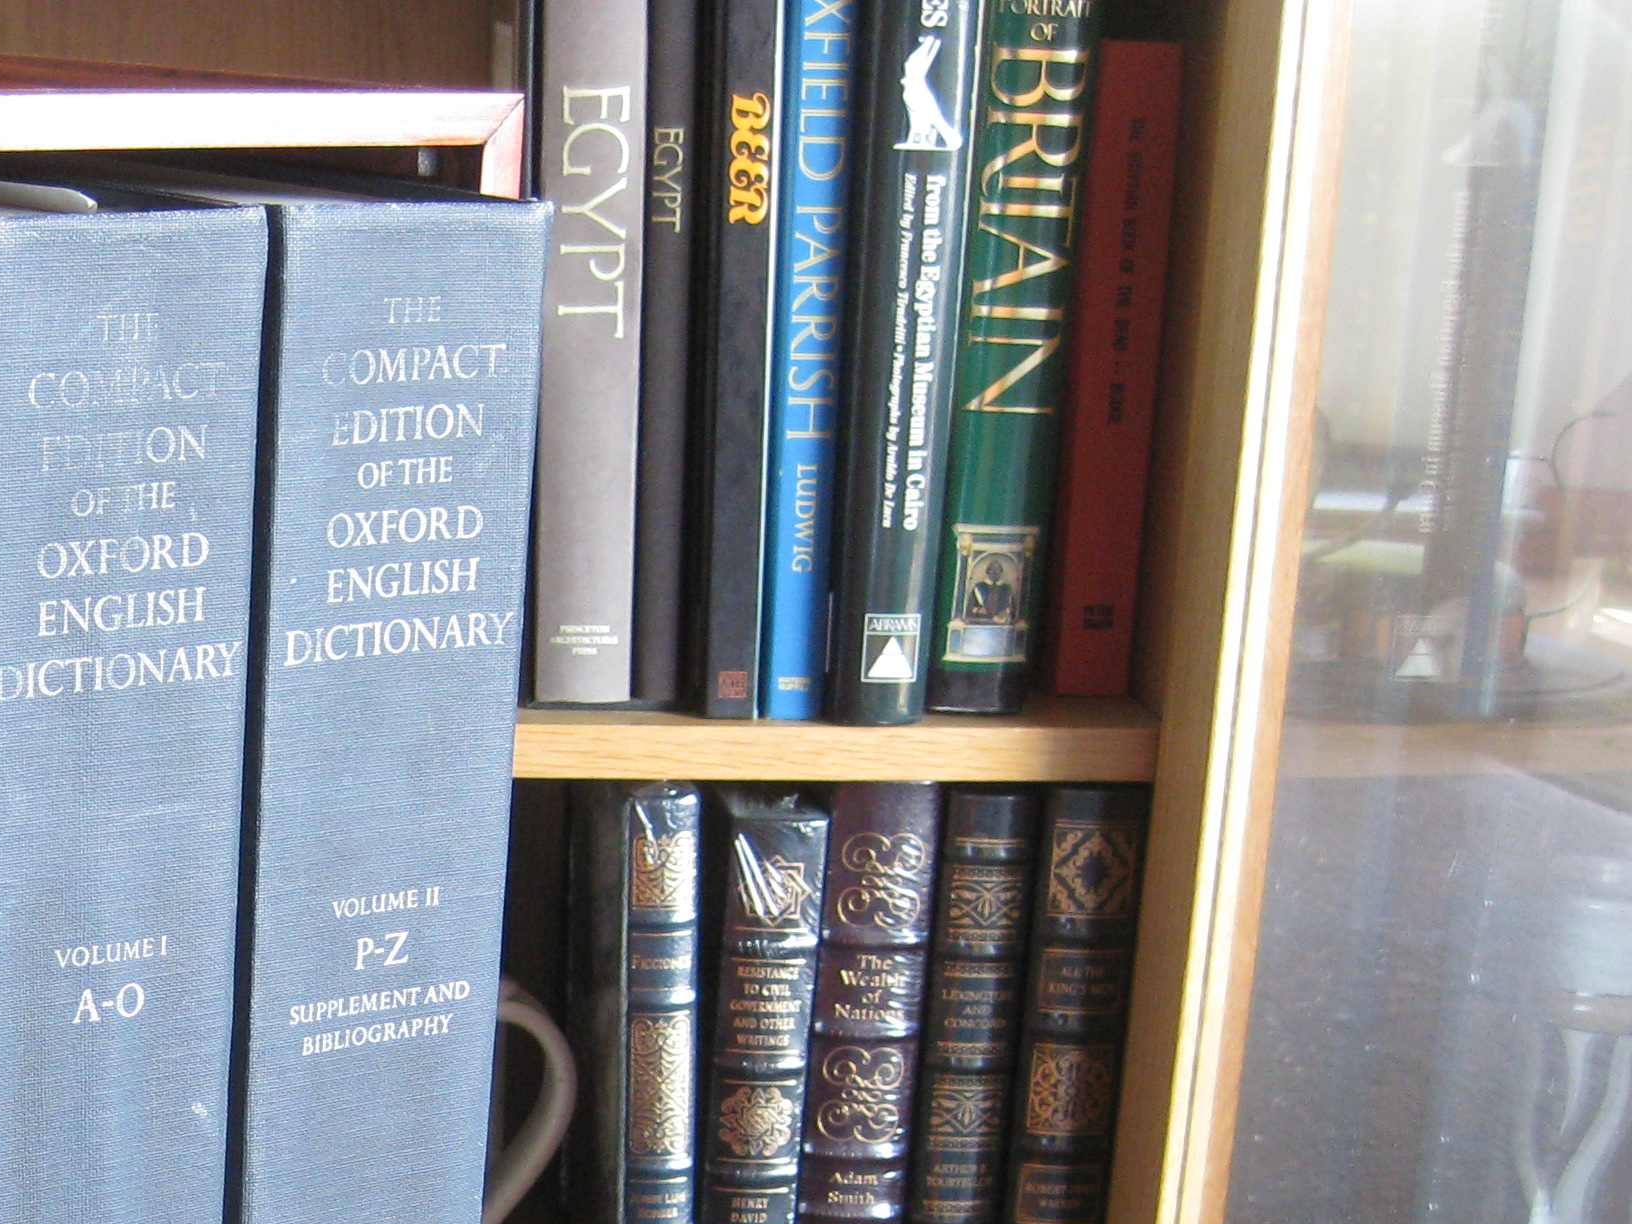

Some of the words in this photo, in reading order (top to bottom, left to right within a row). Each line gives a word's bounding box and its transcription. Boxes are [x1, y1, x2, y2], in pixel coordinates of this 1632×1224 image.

[1030, 23, 1058, 41] OF
[728, 92, 771, 225] BEER
[651, 126, 685, 234] EGYPT
[903, 172, 918, 212] Edited
[557, 84, 631, 340] EGYPT
[923, 174, 947, 225] from
[899, 213, 915, 229] by
[962, 47, 1090, 415] BRITAIN
[921, 228, 943, 263] the
[383, 295, 442, 325] THE
[786, 205, 844, 440] PARRISH
[913, 265, 941, 358] Egyptian
[321, 343, 508, 388] COMPACT
[28, 361, 228, 409] COMPACT
[909, 361, 935, 447] Museum
[331, 403, 485, 448] EDITION
[884, 426, 901, 442] by
[41, 425, 207, 472] EDITION
[907, 450, 928, 471] in
[357, 459, 394, 490] OF
[396, 455, 454, 485] THE
[70, 487, 110, 518] OF
[120, 480, 176, 512] THE
[791, 463, 818, 573] LUDWIG
[902, 473, 927, 532] Cairo
[325, 504, 484, 549] OXFORD
[36, 532, 210, 580] OXFORD
[325, 557, 481, 605] ENGLISH
[36, 587, 206, 638] ENGLISH
[283, 611, 515, 667] DICTIONARY
[331, 888, 421, 918] VOLUME
[423, 886, 441, 908] II
[55, 937, 155, 969] VOLUME
[158, 935, 168, 956] I
[354, 931, 410, 970] P-Z
[857, 954, 894, 970] The
[736, 966, 800, 981] RESISTANCE
[743, 983, 759, 995] TO
[761, 984, 792, 997] CIVIL
[839, 969, 907, 988] Wealth
[72, 982, 146, 1026] A-O
[288, 987, 422, 1026] SUPPLEMENT
[423, 980, 472, 1006] AND
[728, 1000, 802, 1014] GOVERNMENT
[833, 1002, 906, 1021] Nations
[861, 988, 884, 1004] of
[962, 1004, 994, 1016] AND
[301, 1013, 454, 1057] BIBLIOGRAPHY
[733, 1017, 759, 1029] AND
[760, 1018, 796, 1031] OTHER
[737, 1034, 791, 1047] WRITINGS
[829, 1170, 879, 1186] Adam
[731, 1197, 768, 1209] HENRY
[827, 1190, 876, 1206] Smith
[730, 1212, 768, 1224] DAVID
